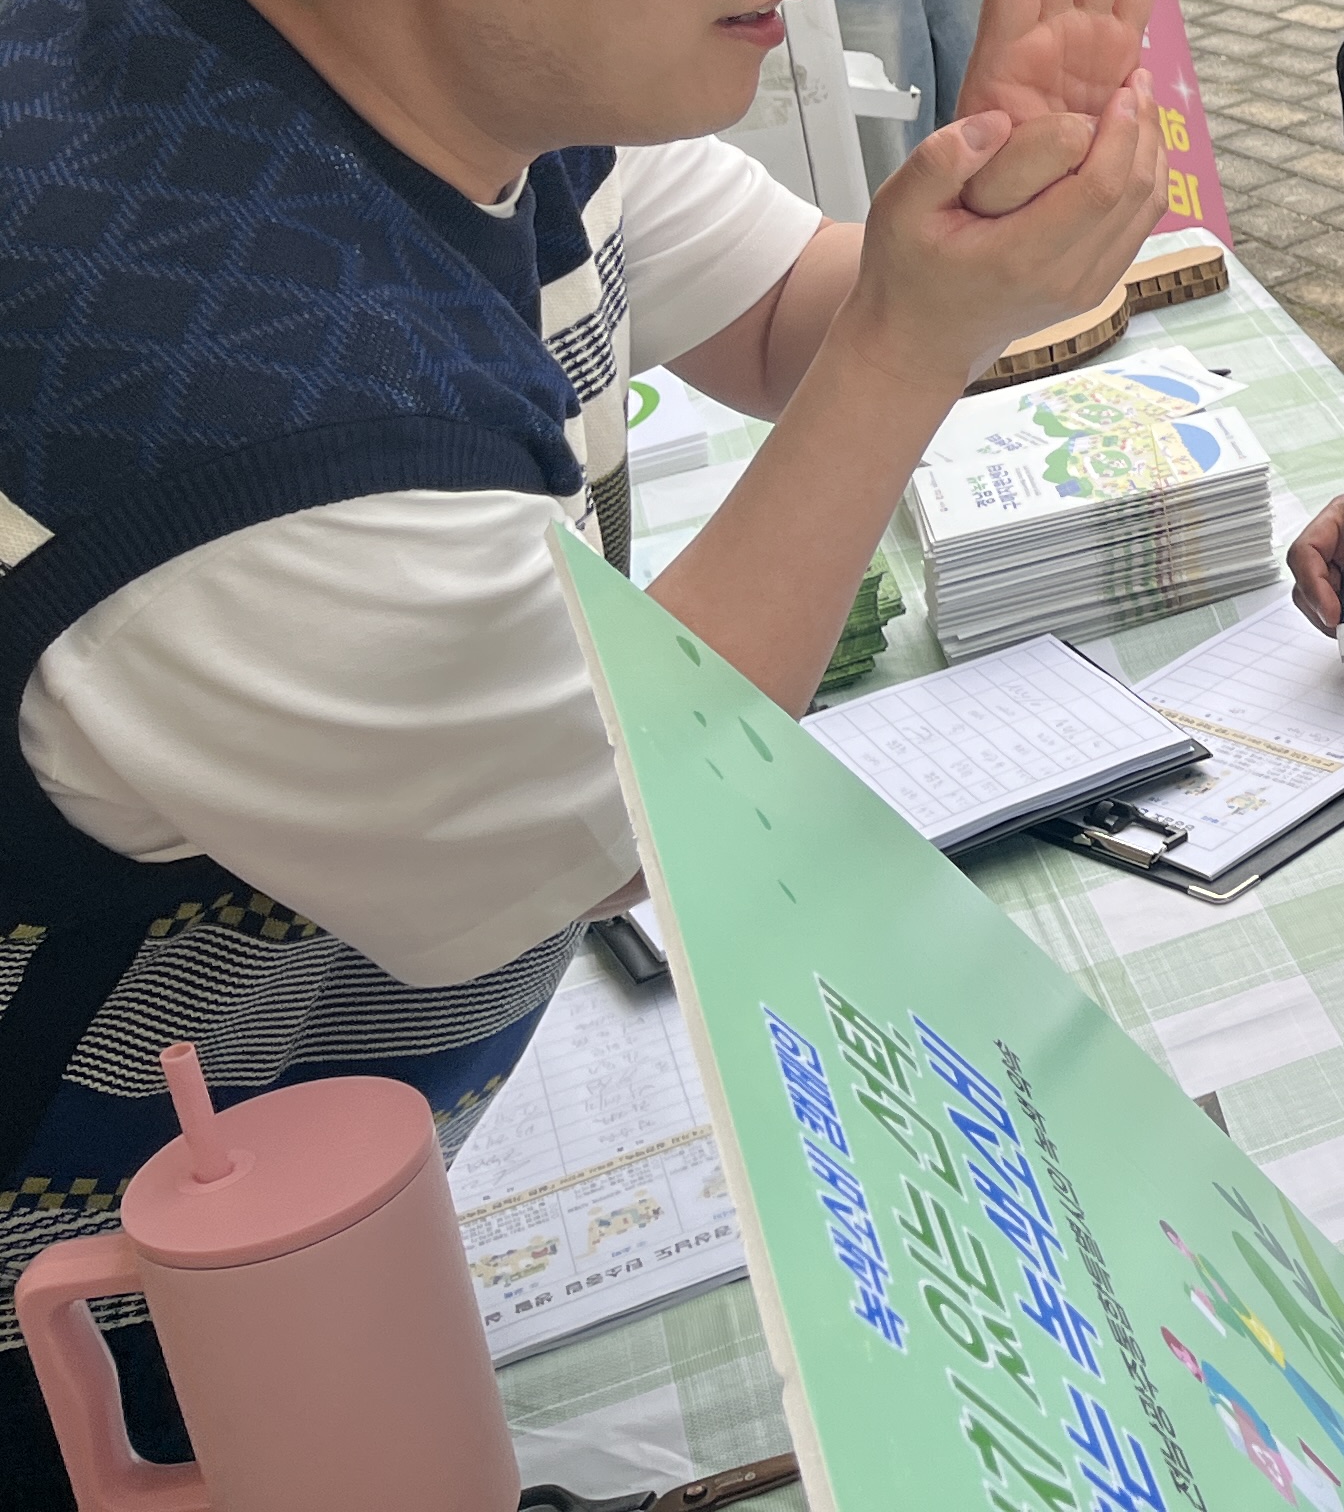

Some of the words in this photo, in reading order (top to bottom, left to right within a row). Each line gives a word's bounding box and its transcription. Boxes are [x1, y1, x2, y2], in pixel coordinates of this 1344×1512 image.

[760, 1002, 853, 1159] 캠페인
[816, 974, 967, 1201] 선택,
[1014, 1090, 1060, 1164] 녹색
[805, 1137, 908, 1352] 녹색소비
[895, 1175, 1047, 1415] 있는
[909, 1011, 1103, 1381] 녹색소비
[1041, 1154, 1207, 1512] 전남광주통합특별시의
[948, 1370, 1080, 1512] 치
[1062, 1382, 1168, 1512] 는
